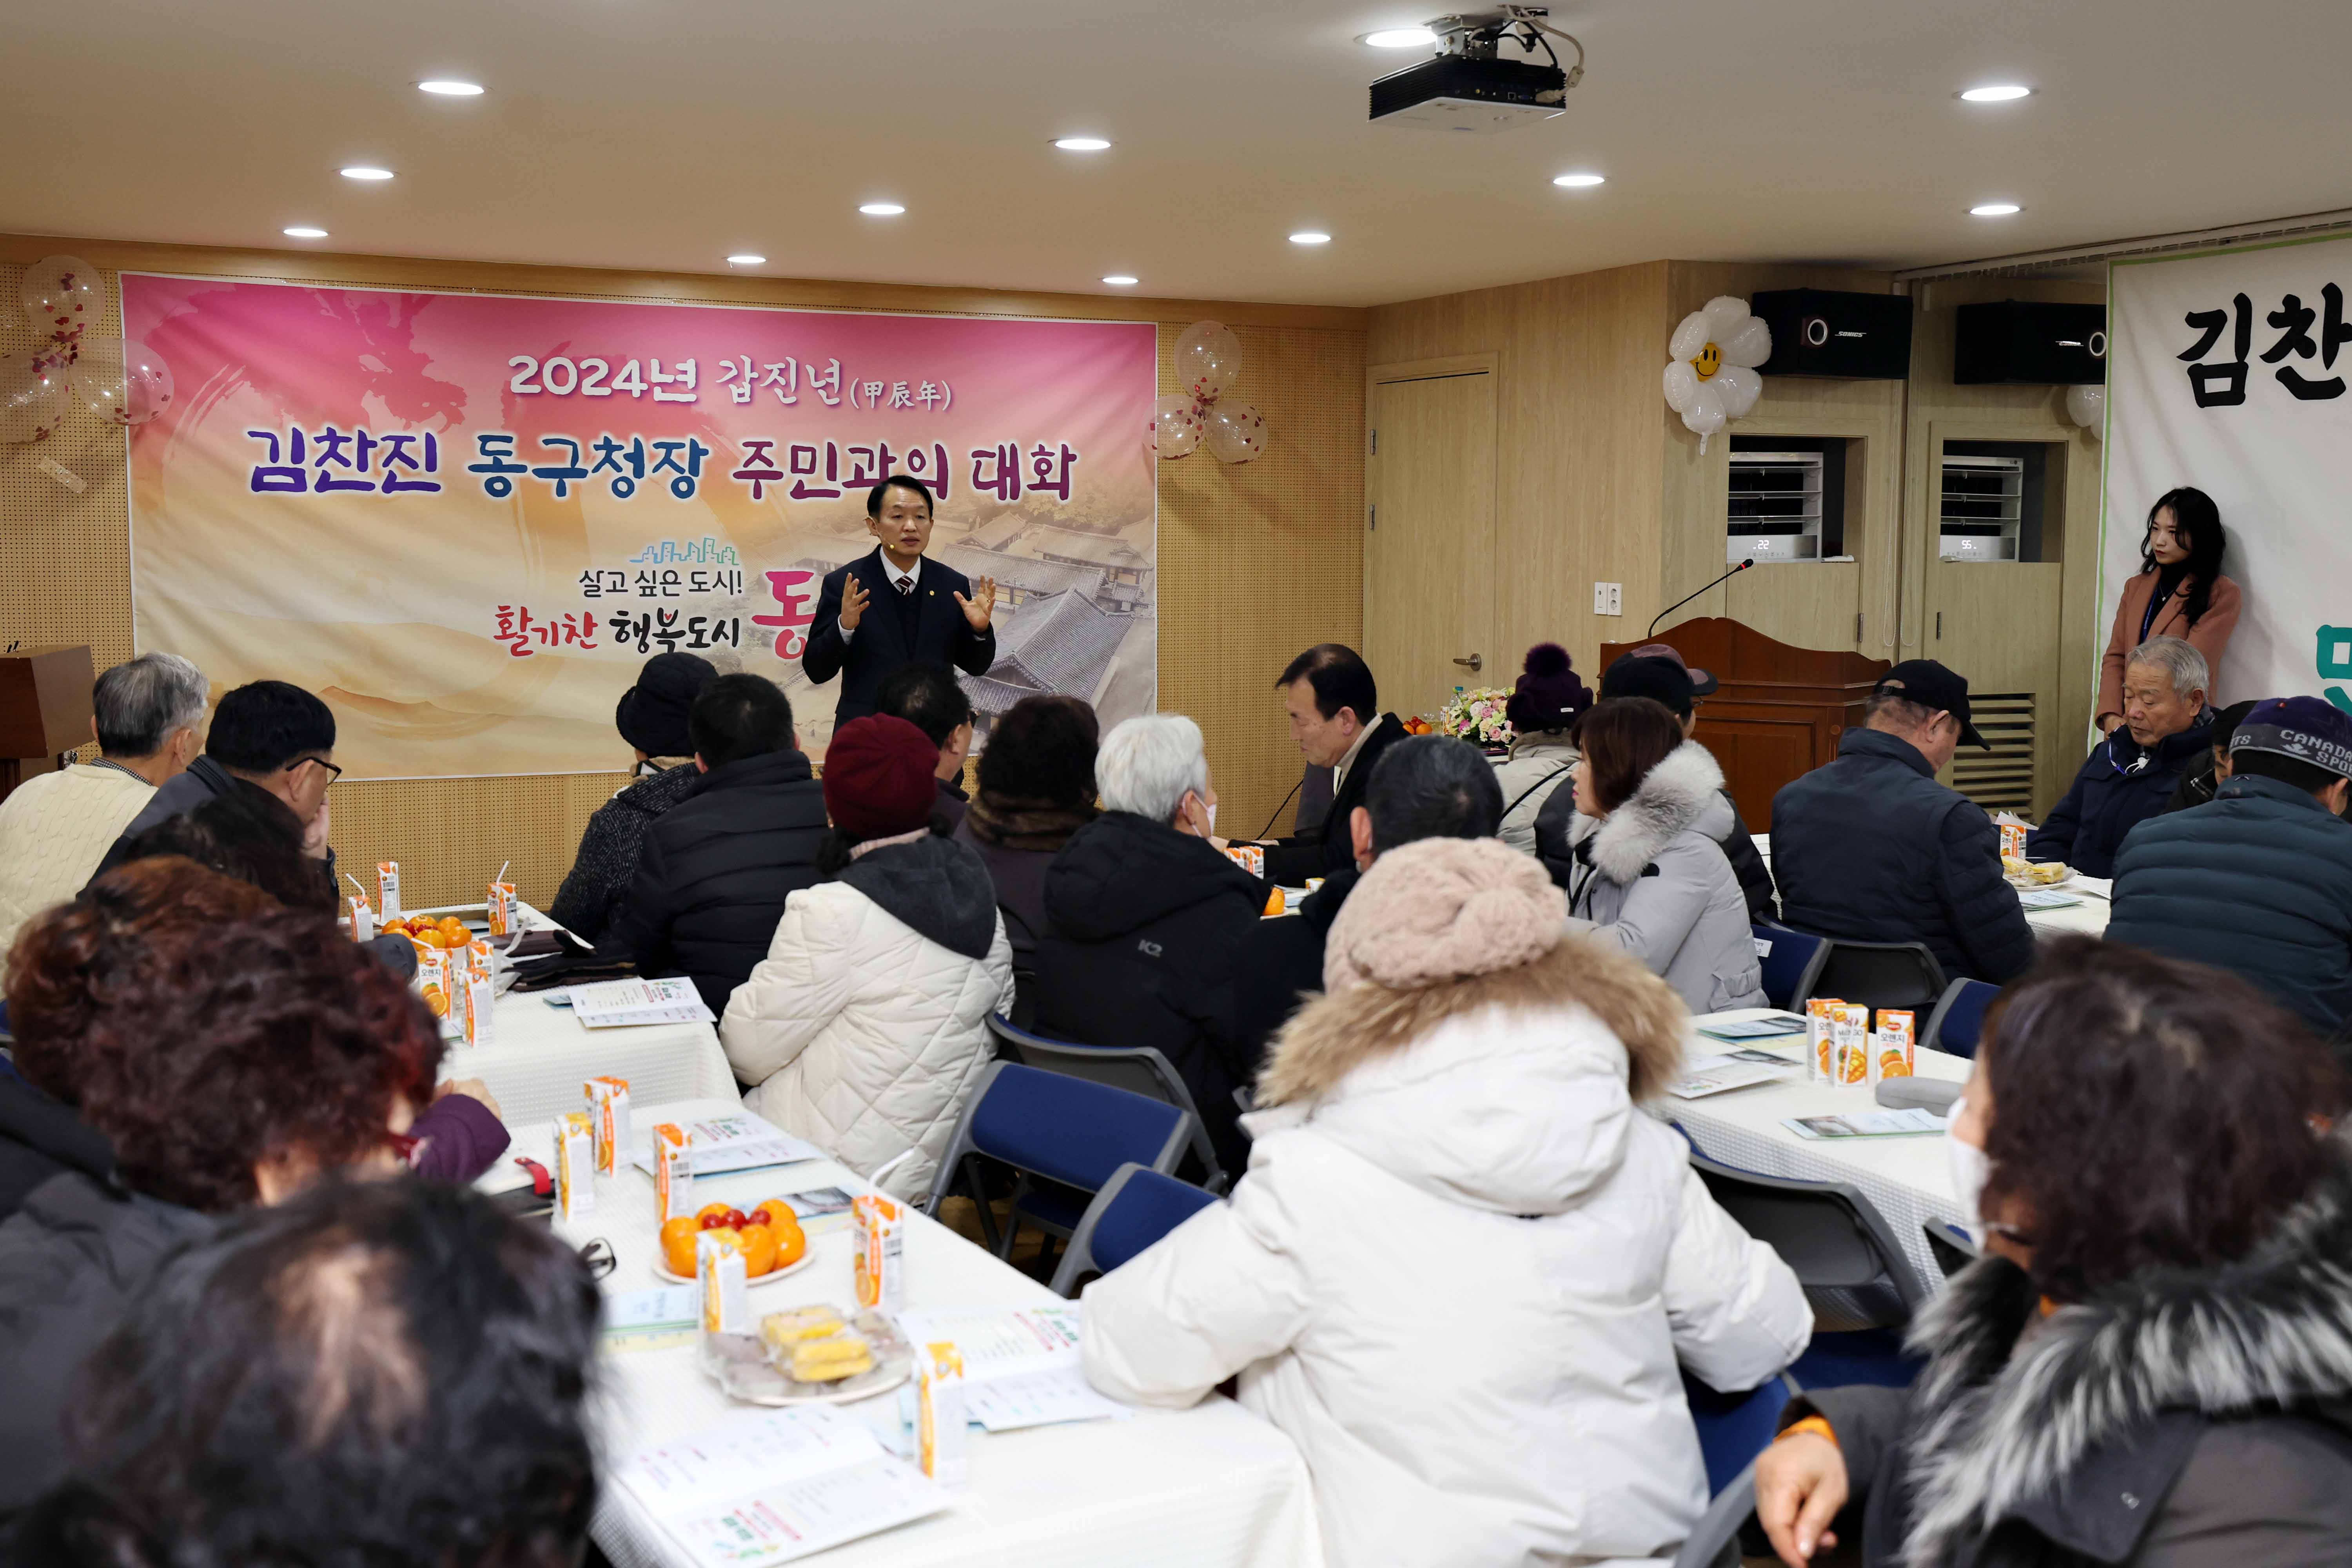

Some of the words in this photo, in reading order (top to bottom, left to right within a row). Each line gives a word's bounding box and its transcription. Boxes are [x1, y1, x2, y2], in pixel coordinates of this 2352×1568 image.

[2176, 282, 2352, 408] 김찬
[508, 355, 697, 403] 2024년
[247, 426, 441, 494] 김찬진
[468, 435, 709, 500] 동구청장
[732, 441, 949, 500] 주민과의
[971, 443, 1077, 501] 대화
[579, 569, 628, 598] 살고
[634, 570, 682, 597] 싶은
[688, 570, 742, 596] 도시!
[493, 605, 599, 657] 활기찬
[609, 607, 739, 654] 행복도시
[2279, 730, 2352, 762] CANADA
[421, 969, 441, 977] 오렌지
[1880, 1033, 1905, 1043] 오렌지
